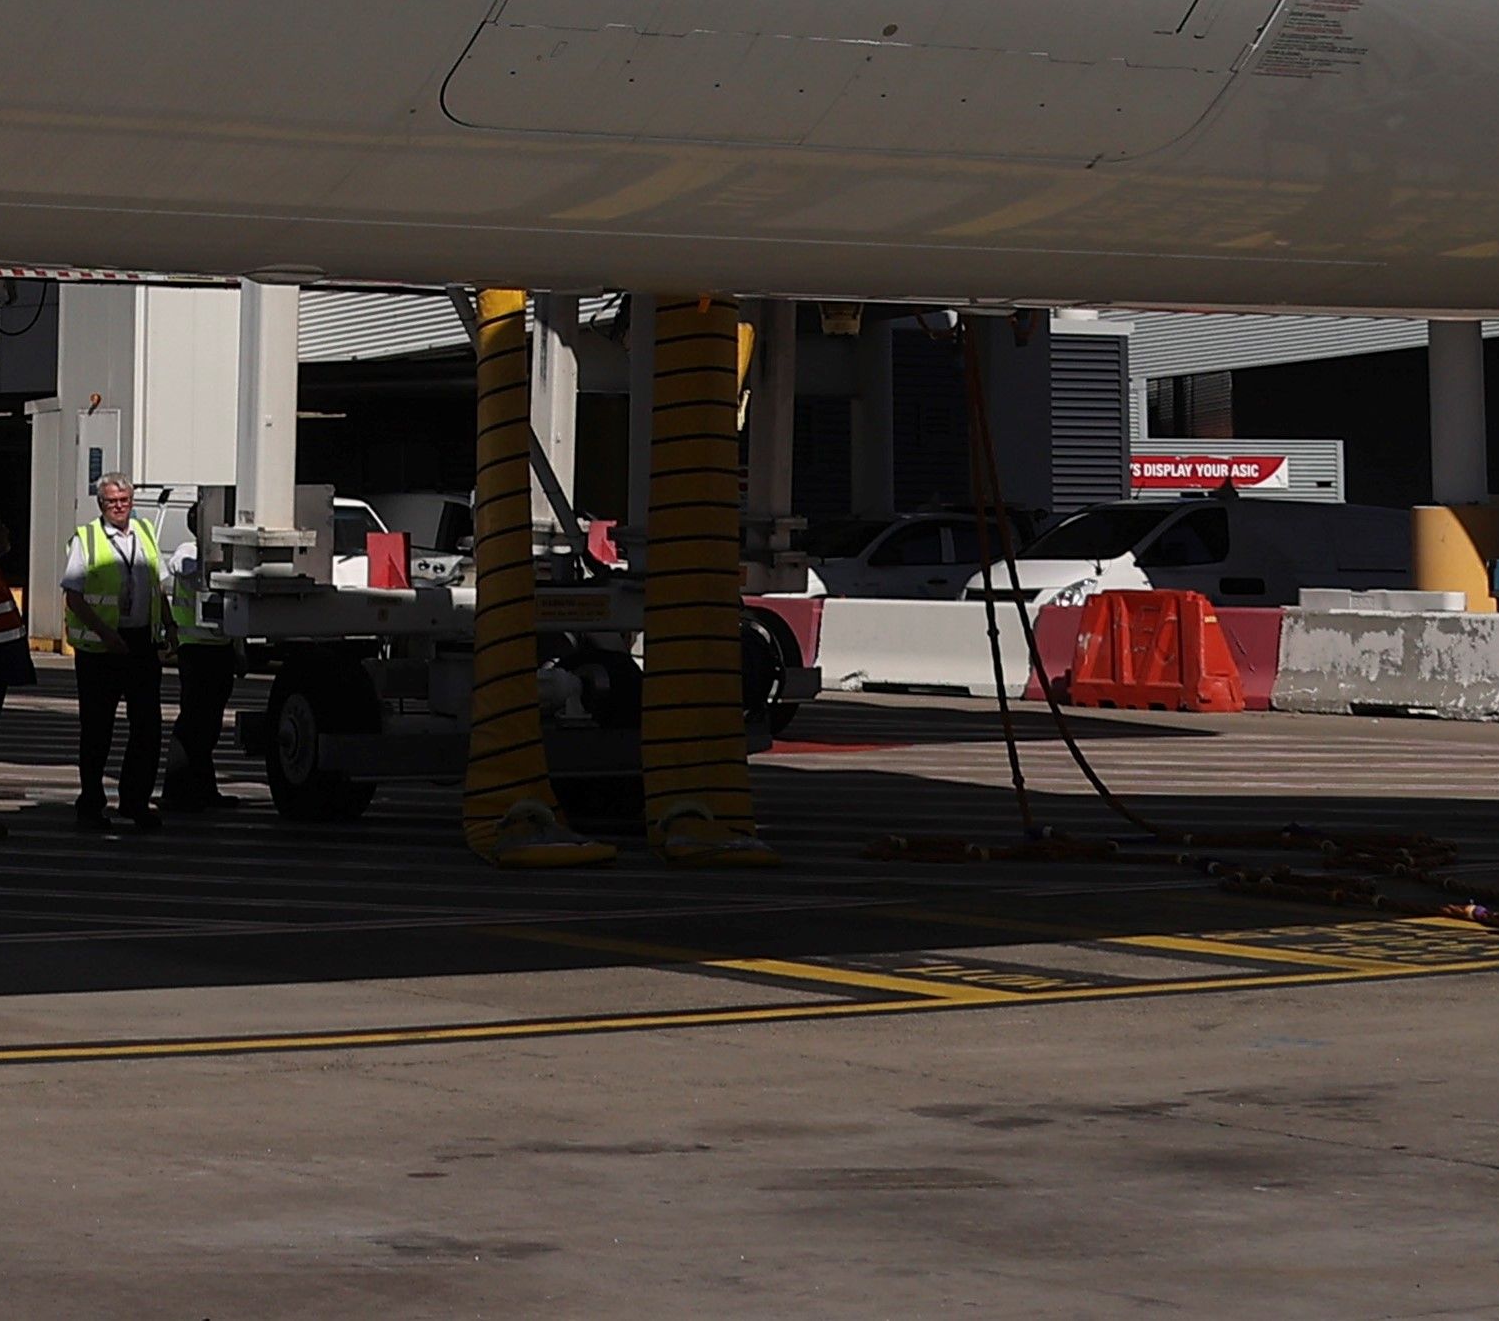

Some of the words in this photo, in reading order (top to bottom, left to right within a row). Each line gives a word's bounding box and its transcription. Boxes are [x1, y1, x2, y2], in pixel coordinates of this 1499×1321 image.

[1144, 464, 1192, 477] DISPLAY
[1195, 464, 1229, 477] YOUR
[1230, 464, 1259, 478] ASIC
